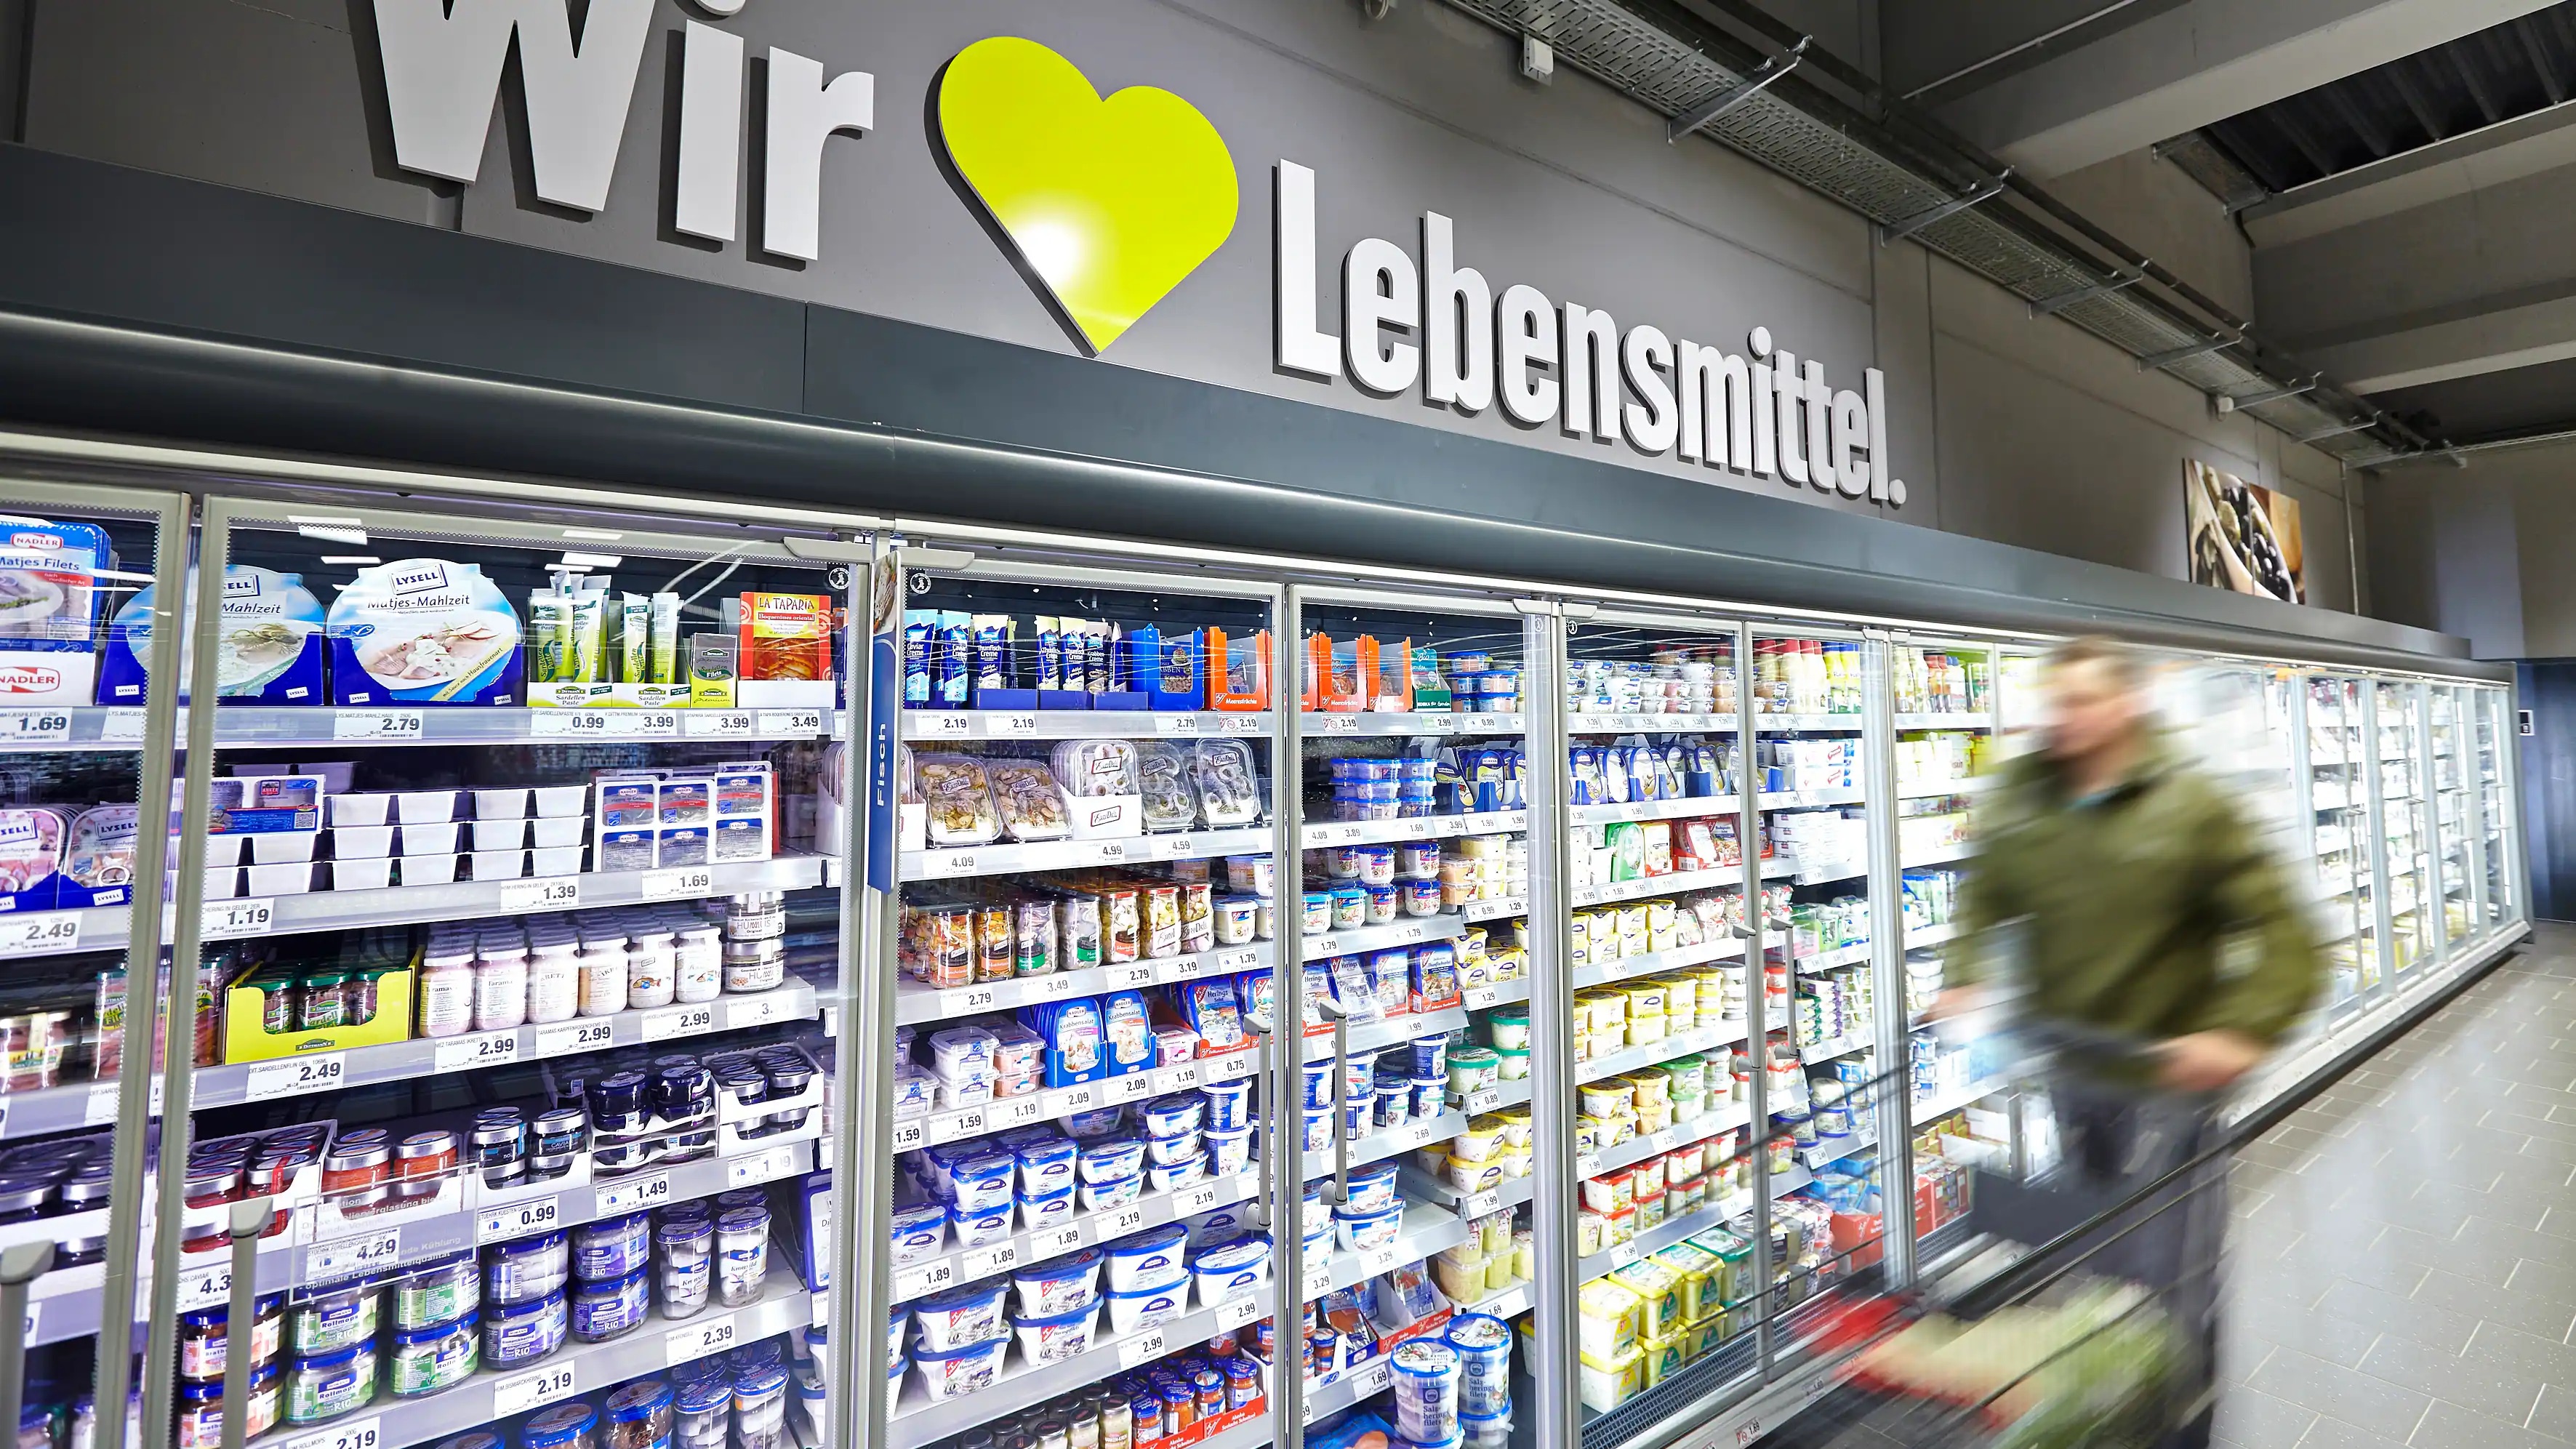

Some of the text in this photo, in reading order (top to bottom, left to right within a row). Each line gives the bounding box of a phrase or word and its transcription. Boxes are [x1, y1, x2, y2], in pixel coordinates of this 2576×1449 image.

[373, 0, 1906, 505] Wir Lebensmittel.
[44, 558, 79, 570] Filets
[396, 572, 438, 585] LYSELL
[368, 595, 470, 611] Matjes-Mahlzeit
[758, 598, 771, 609] LA
[468, 648, 503, 675] Hausfrauenart
[0, 675, 55, 684] NADLER
[19, 717, 67, 731] 1.69
[382, 718, 420, 731] 2.79
[572, 717, 604, 728] 0.99
[644, 717, 673, 728] 3.99
[721, 718, 749, 728] 3.99
[792, 717, 818, 727] 3.49
[944, 719, 966, 728] 2.19
[1013, 719, 1034, 728] 2.19
[877, 723, 886, 806] Fisch
[1410, 824, 1424, 832] 1.69
[1450, 820, 1463, 829] 3.99
[1481, 819, 1493, 827] 1.99
[1312, 831, 1328, 840] 4.09
[1345, 829, 1360, 838] 3.89
[1103, 846, 1122, 856] 4.99
[1172, 841, 1190, 851] 4.59
[952, 856, 974, 867] 4.09
[680, 875, 708, 887] 1.69
[544, 886, 576, 899] 1.39
[1482, 906, 1495, 915] 0.99
[228, 909, 269, 925] 1.19
[28, 923, 76, 940] 2.49
[1408, 928, 1421, 937] 1.79
[1322, 941, 1336, 951] 1.79
[1240, 953, 1256, 963] 1.79
[1179, 962, 1197, 973] 3.19
[1130, 969, 1149, 981] 2.79
[1304, 975, 1323, 984] Herings
[1048, 980, 1068, 992] 3.49
[969, 993, 991, 1006] 2.79
[1482, 992, 1495, 1002] 1.29
[681, 1013, 710, 1027] 2.99
[1108, 1011, 1140, 1020] Krabbensalat
[1060, 1019, 1094, 1029] Krabbensalat
[578, 1026, 611, 1042] 2.99
[479, 1038, 514, 1055] 2.99
[300, 1063, 340, 1081] 2.49
[1227, 1060, 1245, 1072] 0.75
[1176, 1070, 1194, 1082] 1.19
[1127, 1079, 1146, 1091] 2.09
[1069, 1093, 1089, 1105] 2.09
[1485, 1093, 1498, 1104] 0.89
[1015, 1104, 1035, 1117] 1.19
[958, 1115, 981, 1130] 1.59
[896, 1128, 920, 1143] 1.59
[1416, 1128, 1429, 1140] 2.69
[1589, 1161, 1600, 1170] 1.99
[637, 1181, 667, 1199] 1.49
[1195, 1192, 1213, 1205] 2.19
[1484, 1195, 1497, 1206] 1.99
[521, 1205, 555, 1224] 0.99
[1120, 1212, 1139, 1227] 2.19
[1057, 1230, 1078, 1245] 1.89
[356, 1238, 396, 1260] 4.29
[1624, 1247, 1635, 1258] 1.99
[992, 1249, 1014, 1264] 1.89
[1378, 1251, 1393, 1264] 3.29
[593, 1268, 605, 1277] RIO
[926, 1267, 950, 1284] 1.89
[1314, 1276, 1330, 1290] 3.29
[1238, 1303, 1256, 1317] 2.99
[1489, 1305, 1501, 1317] 1.69
[322, 1314, 358, 1328] Rollmops
[605, 1321, 618, 1330] RIO
[337, 1331, 353, 1341] RIO
[703, 1325, 732, 1345] 2.39
[1143, 1337, 1163, 1353] 2.99
[515, 1347, 529, 1357] RIO
[538, 1373, 571, 1394] 2.19
[1371, 1371, 1387, 1385] 1.69
[320, 1384, 356, 1399] Rollmops
[334, 1401, 351, 1411] RIO
[1749, 1422, 1760, 1435] 1.69
[337, 1430, 375, 1449] 2.19
